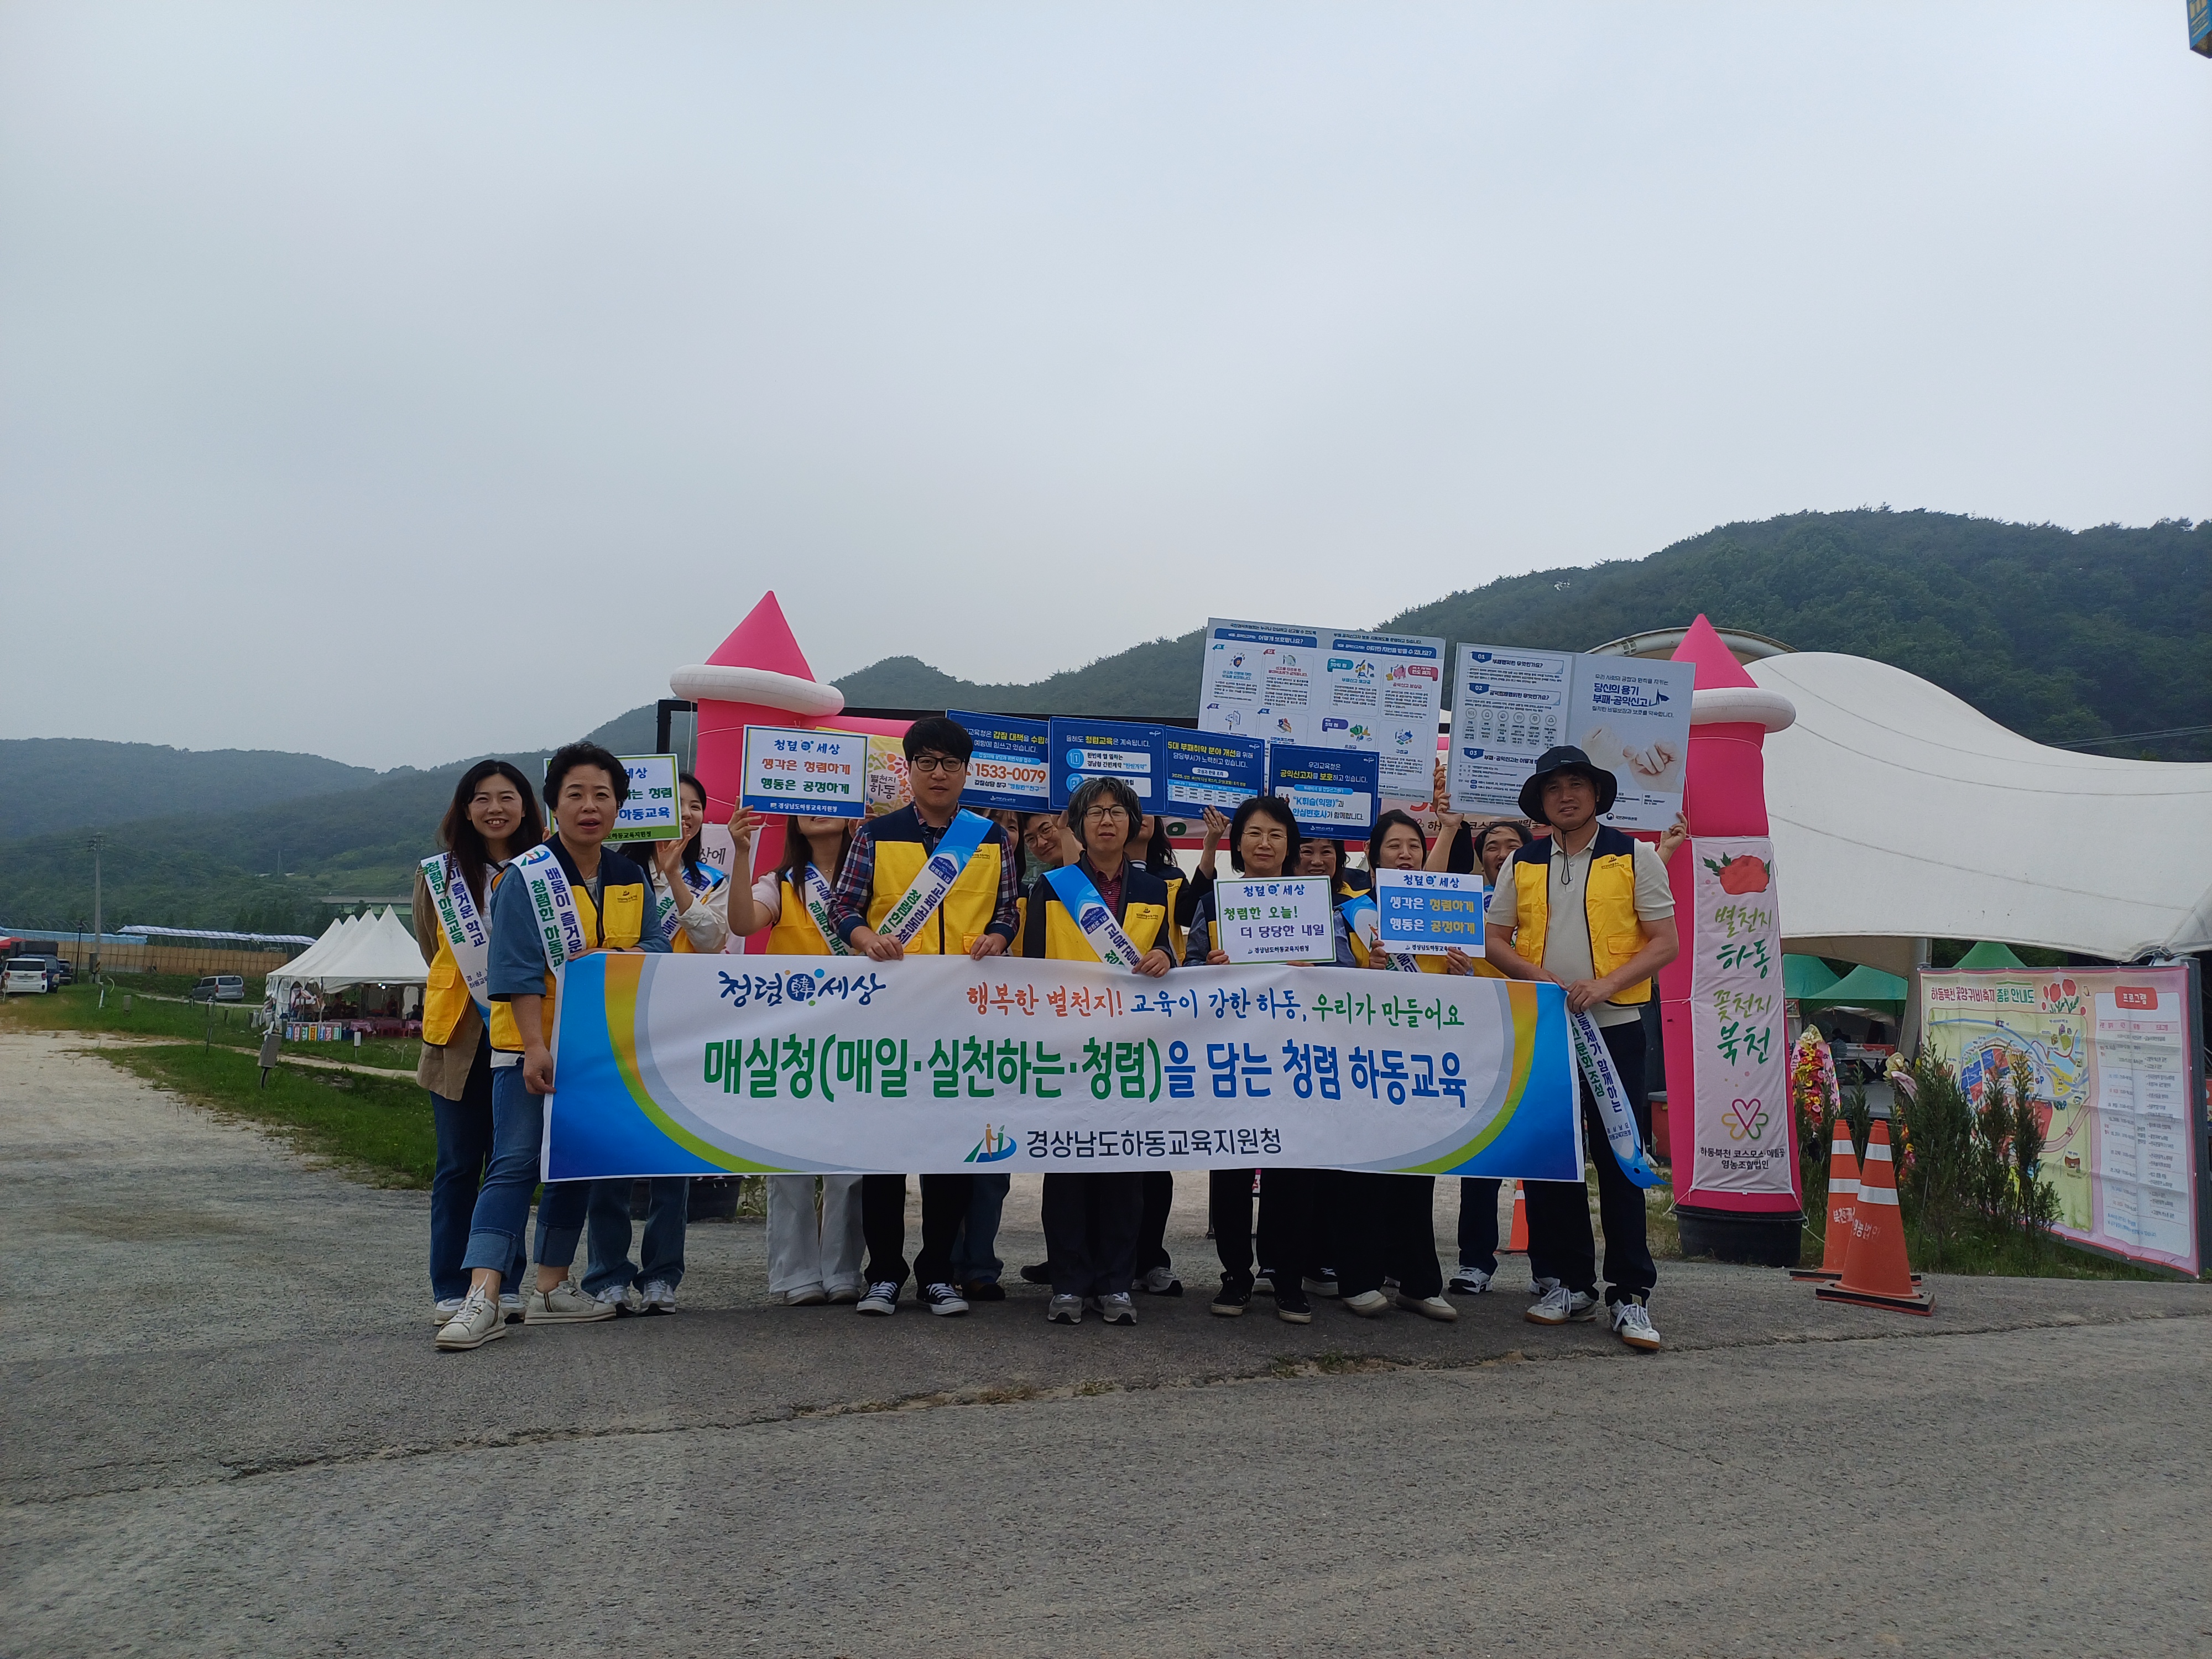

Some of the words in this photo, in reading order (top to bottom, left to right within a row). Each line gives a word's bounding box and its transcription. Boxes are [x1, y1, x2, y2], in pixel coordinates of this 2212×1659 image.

[1594, 683, 1620, 693] 당신의
[1621, 685, 1639, 696] 용기
[1593, 694, 1648, 707] 부패·공익신고
[1009, 733, 1029, 742] 대책을
[1086, 735, 1119, 745] 청렴교육은
[774, 739, 797, 752] 청렴
[816, 743, 841, 755] 세상
[993, 742, 1011, 750] 힘쓰고
[1013, 744, 1037, 753] 있습니다.
[1167, 741, 1179, 750] 5대
[1180, 743, 1207, 754] 부패취약
[1208, 746, 1222, 755] 분야
[1223, 748, 1241, 758] 개선을
[761, 758, 797, 771] 생각은
[804, 761, 851, 775] 청렴하게
[1224, 759, 1249, 768] 있습니다.
[1308, 761, 1341, 770] 우리교육청은
[870, 774, 896, 784] 별천지
[975, 763, 1046, 783] 1533-0079
[1280, 769, 1318, 780] 공익신고자를
[1319, 773, 1344, 781] 보호하고
[1345, 775, 1368, 784] 있습니다.
[648, 787, 672, 799] 청렴
[760, 778, 797, 791] 행동은
[802, 781, 850, 795] 공정하게
[869, 782, 895, 800] 하동
[619, 806, 670, 821] 하동교육
[1292, 808, 1333, 818] 안심변호사가
[1334, 812, 1364, 821] 함께합니다.
[1428, 820, 1442, 831] 하
[1403, 874, 1425, 886] 청렴
[1439, 877, 1460, 888] 세상
[812, 880, 832, 905] 교육
[1243, 885, 1265, 898] 청렴
[1283, 885, 1305, 897] 세상
[426, 860, 445, 895] 청렴한
[438, 895, 466, 945] 하동교육
[545, 867, 571, 907] 배움이
[560, 911, 582, 954] 즐거운
[888, 889, 922, 928] 청렴한
[1390, 896, 1424, 911] 생각은
[1430, 898, 1475, 913] 청렴하게
[451, 881, 472, 920] 즐거운
[465, 920, 487, 947] 학교
[808, 900, 834, 937] 청렴한
[1223, 906, 1262, 922] 청렴한
[1268, 905, 1298, 920] 오늘!
[1715, 905, 1772, 938] 별천지
[530, 879, 555, 922] 청렴한
[544, 925, 565, 972] 하동교
[1240, 927, 1253, 939] 더
[1259, 925, 1295, 939] 당당한
[1301, 924, 1325, 937] 내일
[1390, 917, 1425, 932] 행동은
[1431, 919, 1475, 935] 공정하게
[1254, 945, 1310, 954] 경상남도하동교육지원청
[1717, 938, 1771, 979] 하동
[718, 969, 783, 1008] 청렴
[791, 975, 813, 999] 韓
[817, 972, 886, 1006] 세상
[1996, 988, 2010, 1003] 종합
[2010, 988, 2035, 1004] 안내도
[967, 982, 1039, 1018] 행복한
[1046, 985, 1123, 1018] 별천지!
[1130, 988, 1199, 1019] 교육이
[1209, 987, 1251, 1021] 강한
[1256, 989, 1307, 1024] 하동,
[1311, 992, 1376, 1027] 우리가
[1381, 996, 1465, 1031] 만들어요
[1713, 989, 1772, 1023] 꽃천지
[2122, 993, 2147, 1005] 프로그램
[1717, 1021, 1771, 1067] 북천
[703, 1032, 1196, 1103] 매실청(매일·실천하는·청렴)을
[1206, 1040, 1272, 1100] 담는
[1281, 1037, 1340, 1103] 청렴
[1348, 1047, 1468, 1109] 하동교육
[1575, 1042, 1594, 1068] 문화
[1588, 1070, 1606, 1098] 조성
[1597, 1058, 1623, 1113] 함께하는
[1026, 1128, 1282, 1160] 경상남도하동교육지원청
[1700, 1146, 1731, 1159] 하동북천
[1721, 1159, 1770, 1170] 영농조합법인
